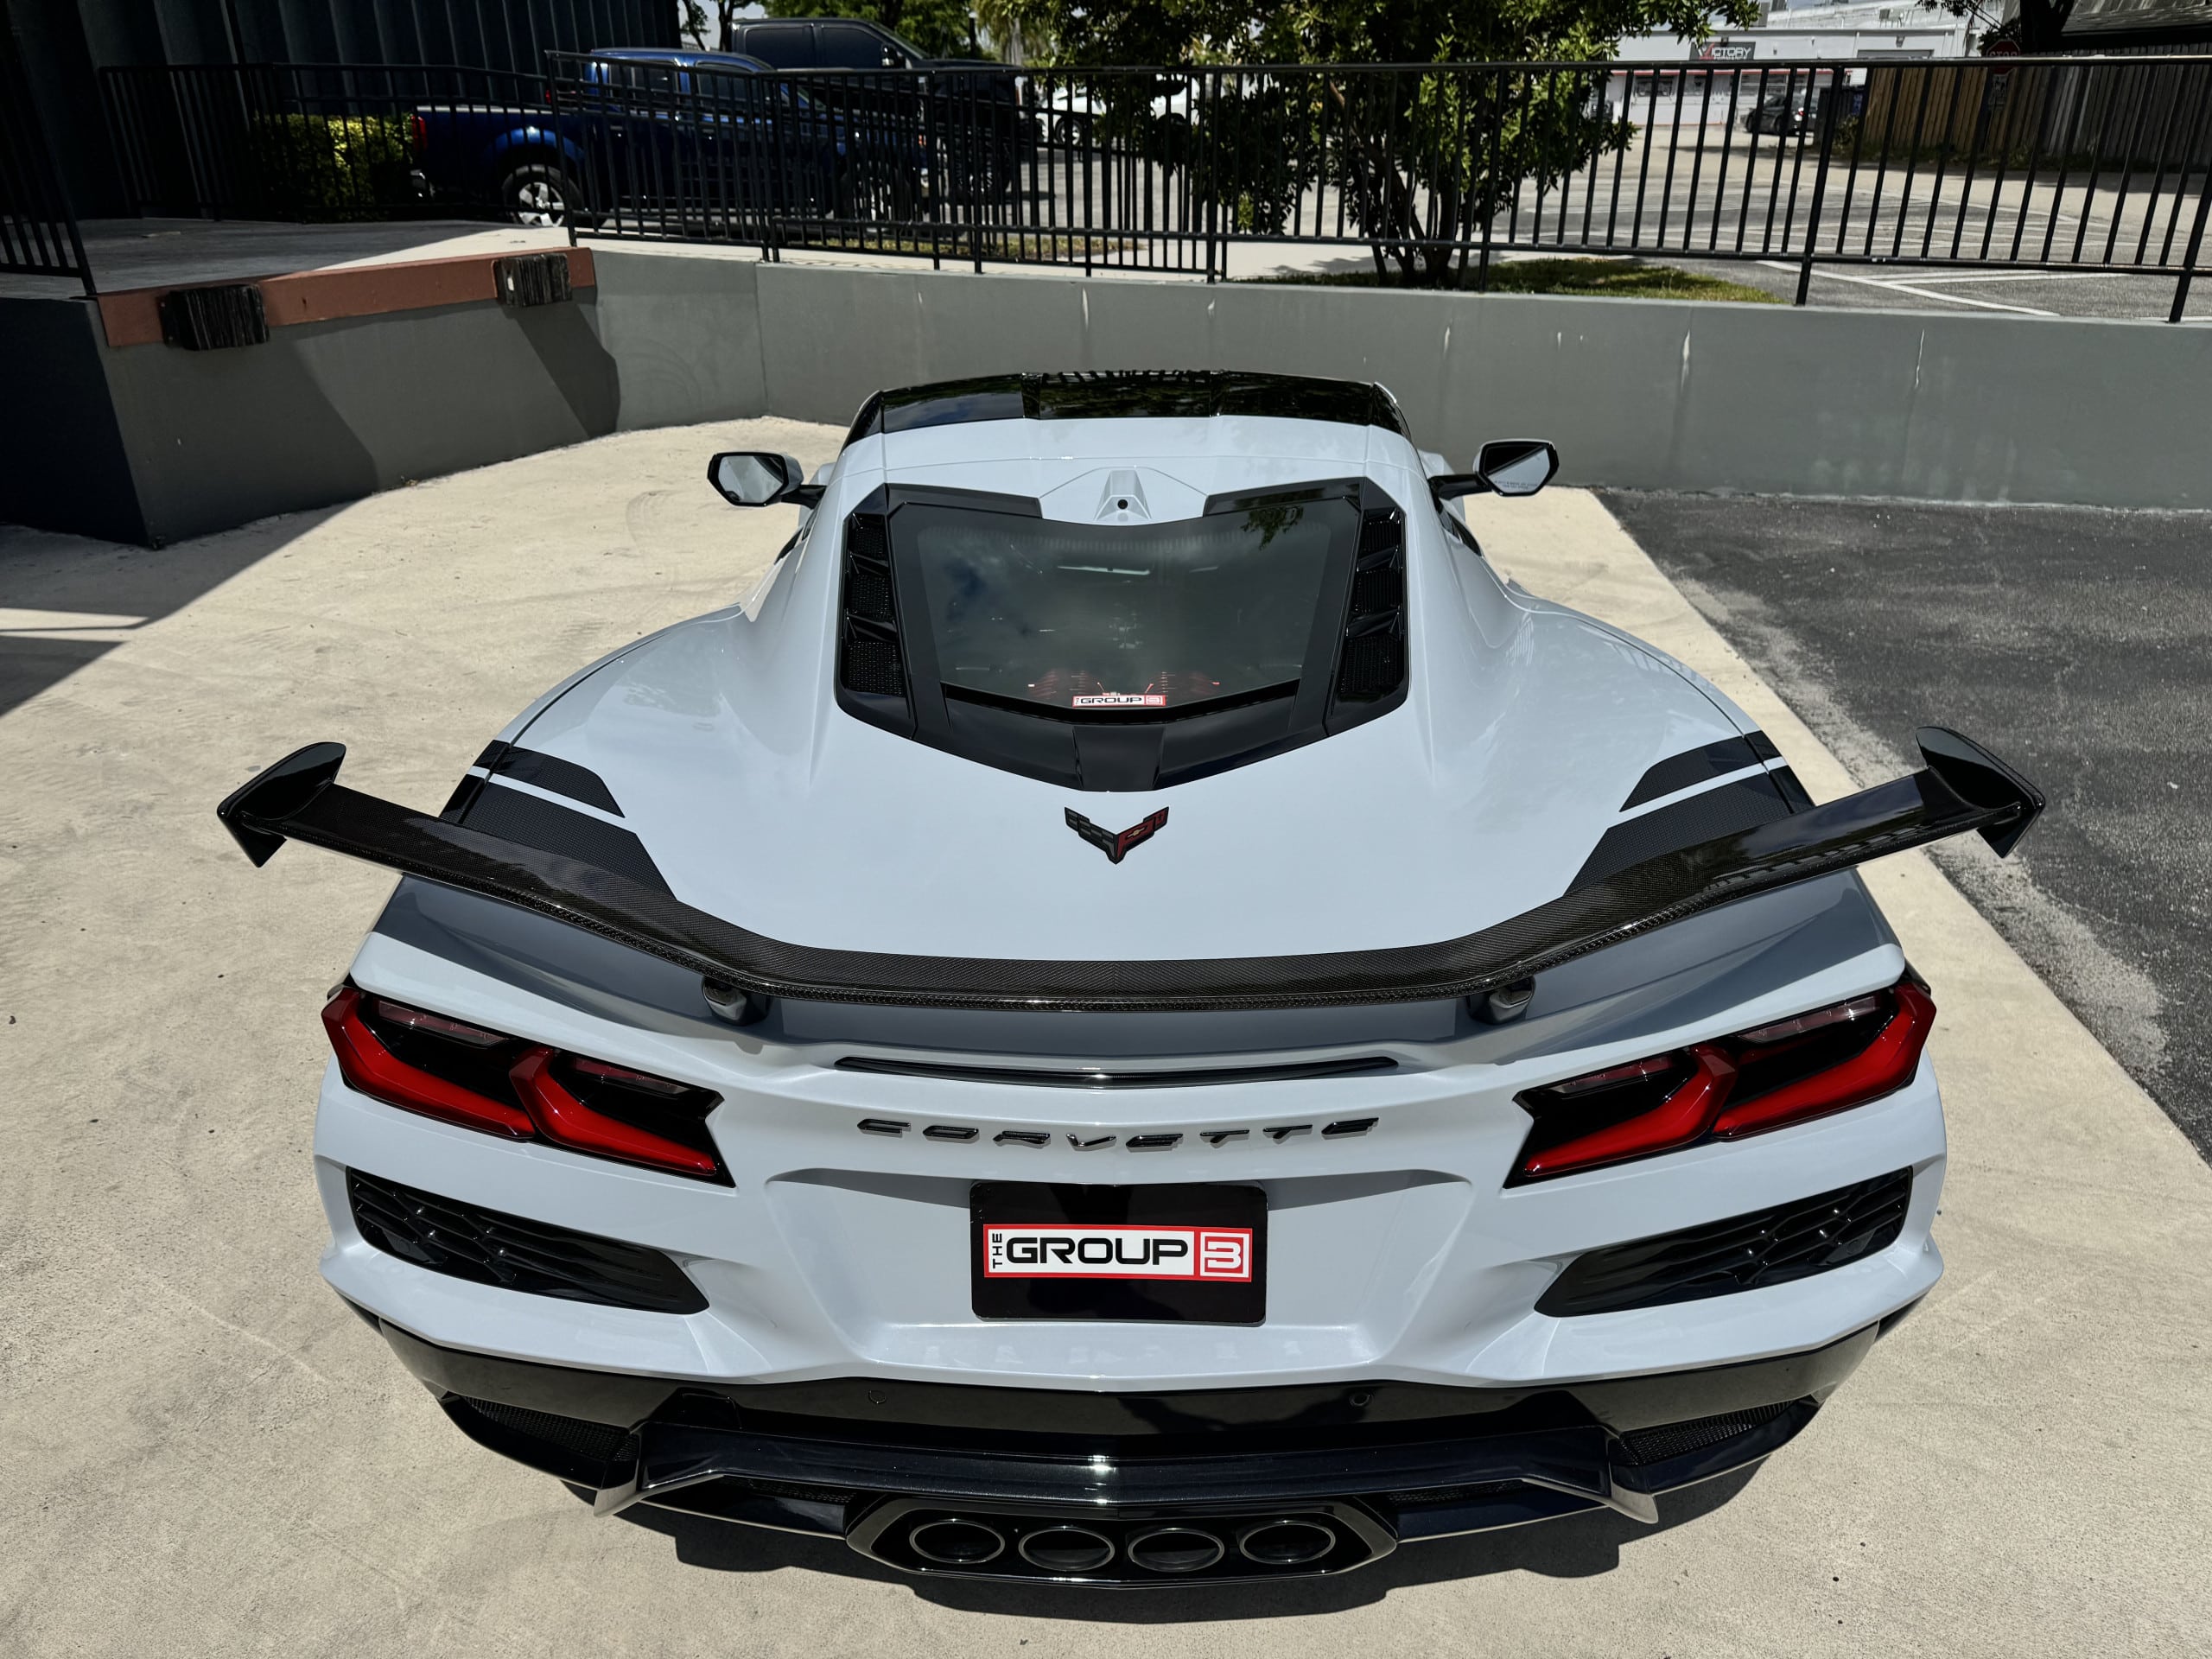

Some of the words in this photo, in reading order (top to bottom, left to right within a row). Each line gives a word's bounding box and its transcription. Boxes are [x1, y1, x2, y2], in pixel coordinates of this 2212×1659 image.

[856, 1116, 1380, 1147] CORVETTE
[992, 1233, 1002, 1268] THE
[1006, 1236, 1189, 1266] GROUP
[1204, 1240, 1243, 1270] 3
